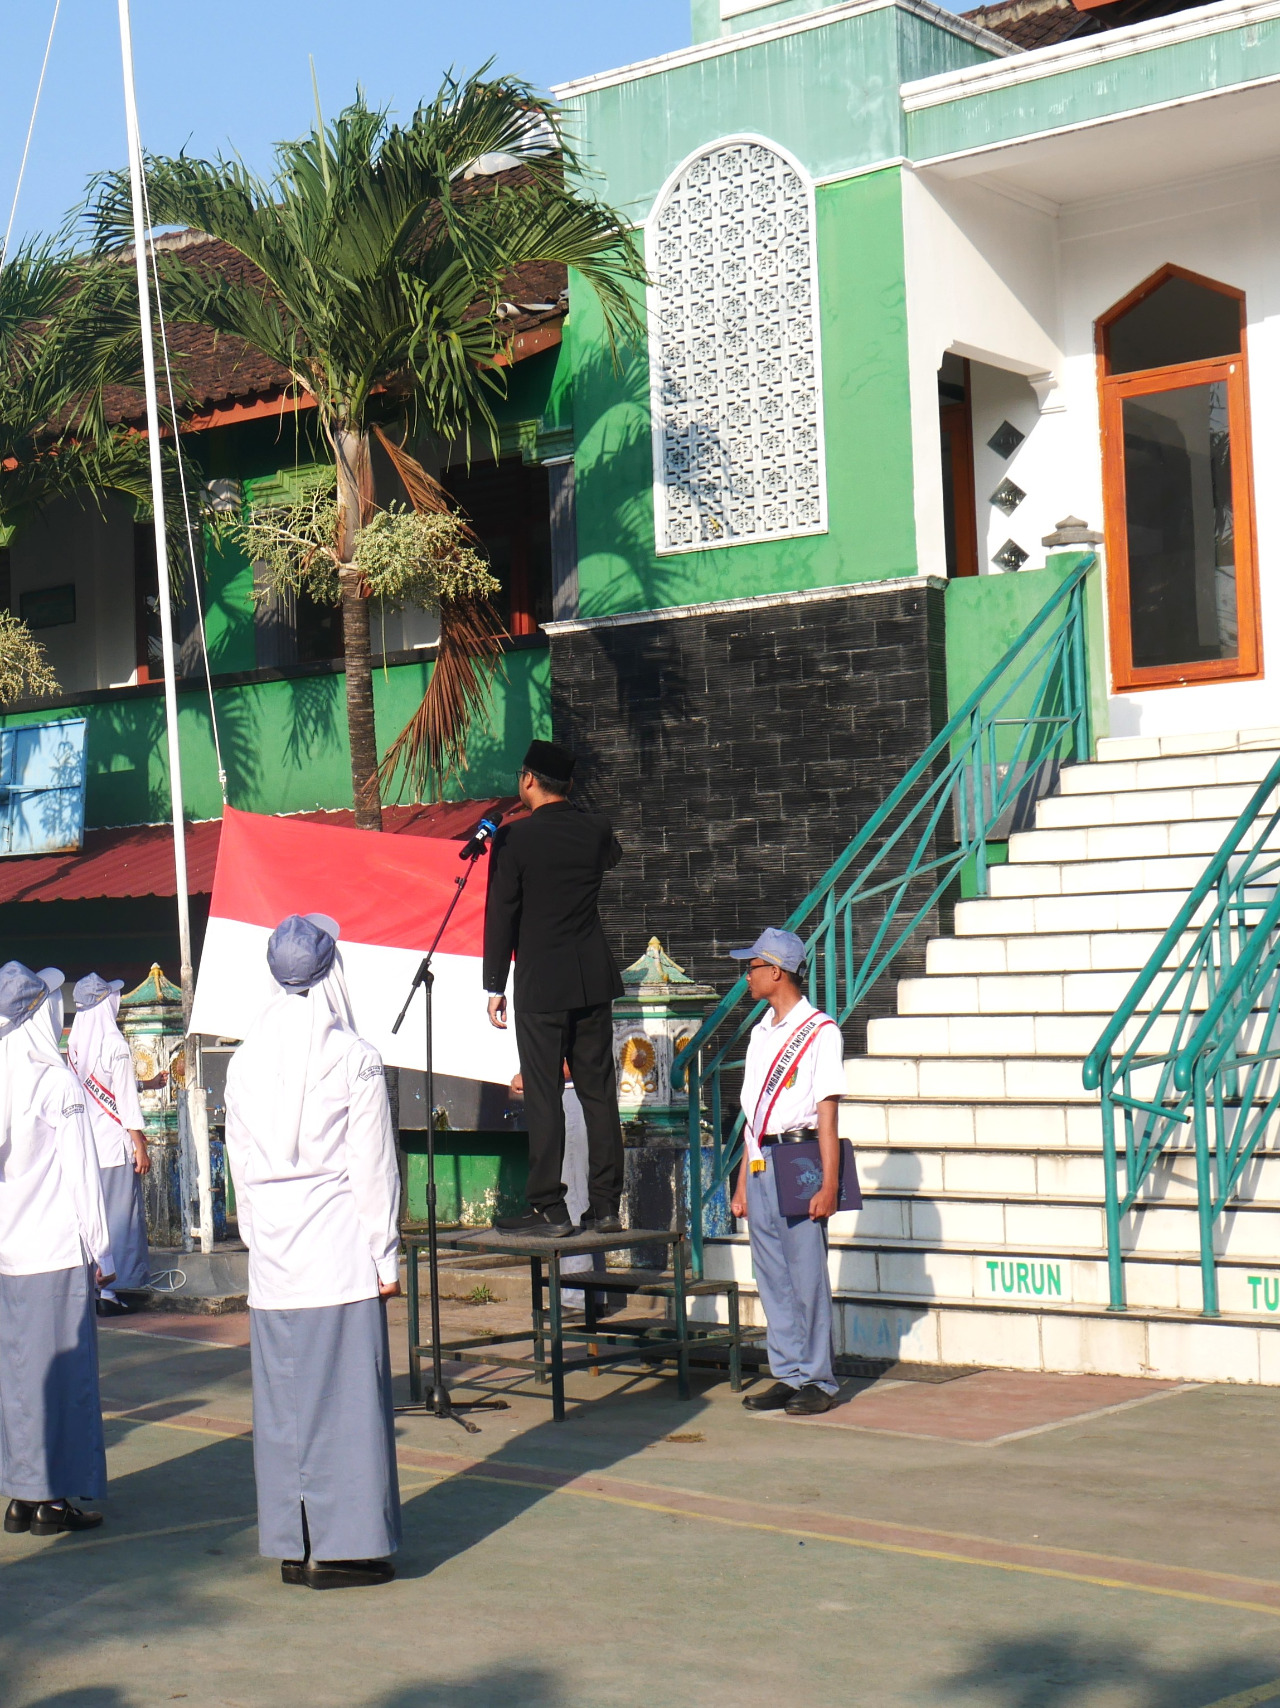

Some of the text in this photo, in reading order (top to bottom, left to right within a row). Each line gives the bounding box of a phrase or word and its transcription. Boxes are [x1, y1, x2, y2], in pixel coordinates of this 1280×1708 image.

[765, 1021, 817, 1095] PEMBAWA TEKS PANCASILA
[986, 1261, 1062, 1296] TURUN
